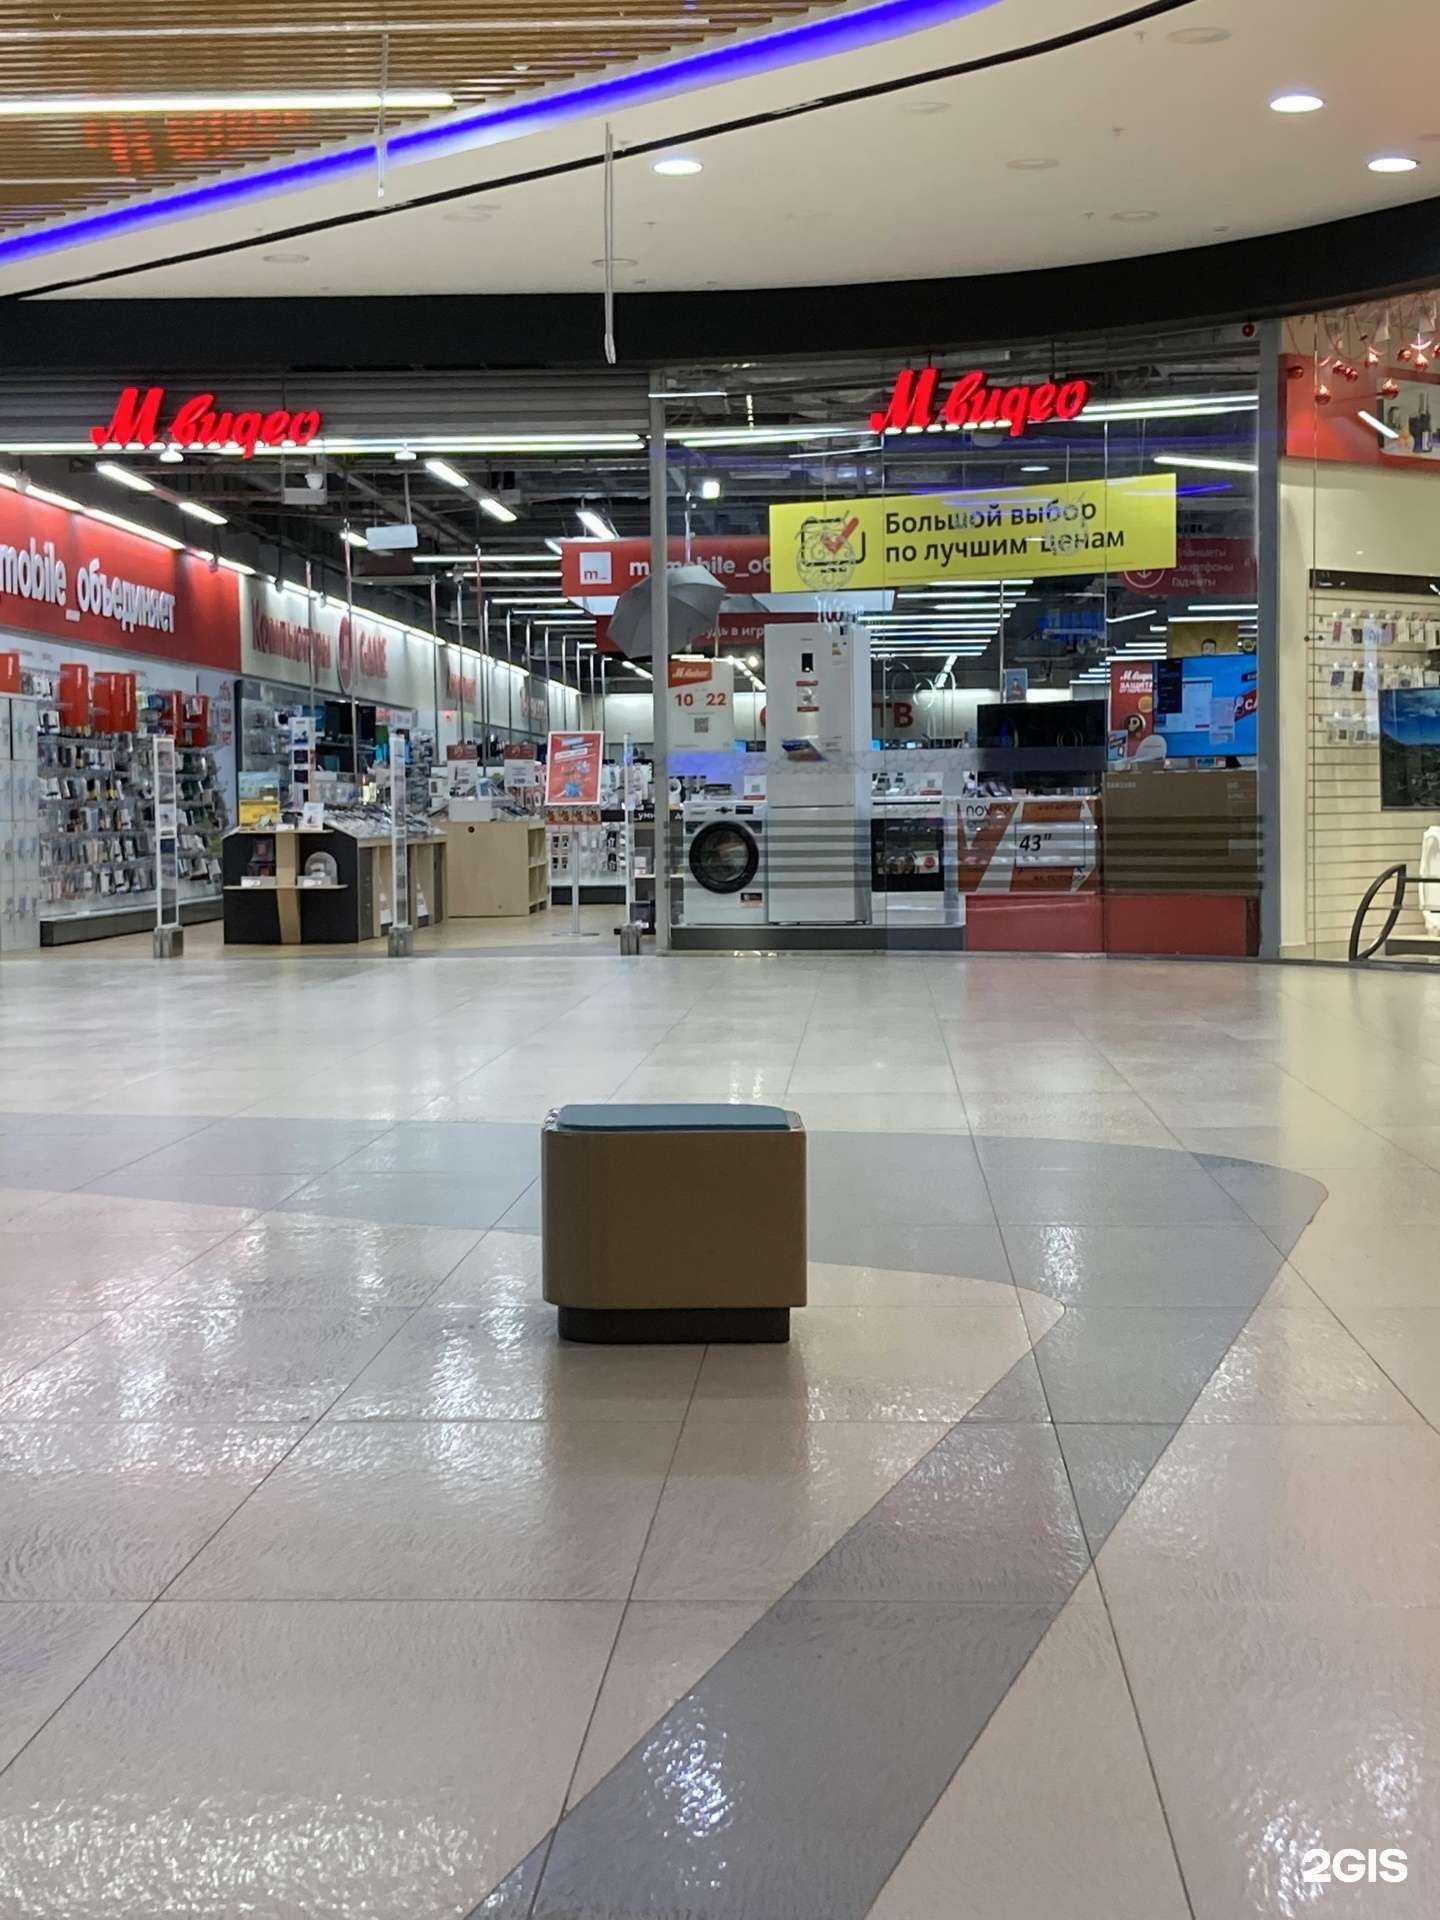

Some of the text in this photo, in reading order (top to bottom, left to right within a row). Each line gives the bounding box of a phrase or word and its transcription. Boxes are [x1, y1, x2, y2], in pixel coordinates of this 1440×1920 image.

[870, 367, 1091, 438] М видео
[89, 386, 322, 460] М видео
[885, 498, 1097, 534] Большой выбор
[885, 529, 1125, 568] по лучшим ценам
[675, 692, 727, 707] 10 22
[1019, 833, 1052, 852] 43"
